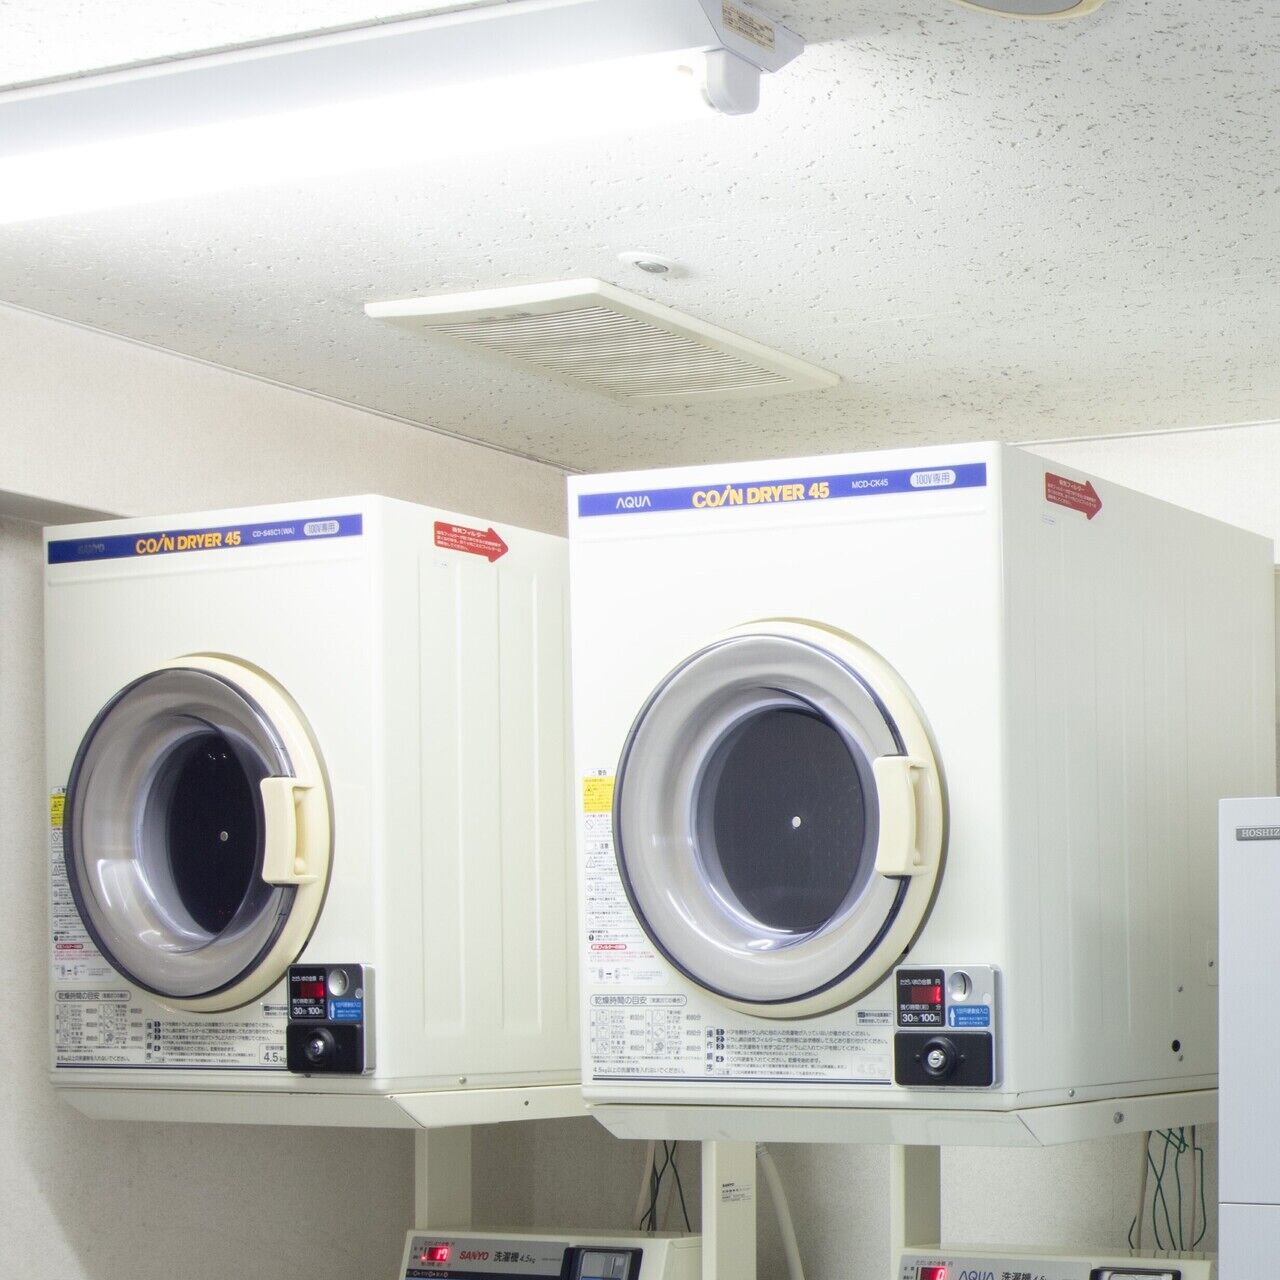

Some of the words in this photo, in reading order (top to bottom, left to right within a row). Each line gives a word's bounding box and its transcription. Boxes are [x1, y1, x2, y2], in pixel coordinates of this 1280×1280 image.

[914, 471, 951, 486] 100V専用
[616, 495, 651, 509] AQUA
[692, 484, 743, 509] COIN
[746, 484, 805, 505] DRYER
[809, 481, 830, 499] 45
[135, 533, 174, 554] COIN
[176, 533, 221, 551] DRYER
[224, 531, 242, 545] 45
[459, 1250, 489, 1261] SANYO
[493, 1251, 520, 1263] 洗濯機
